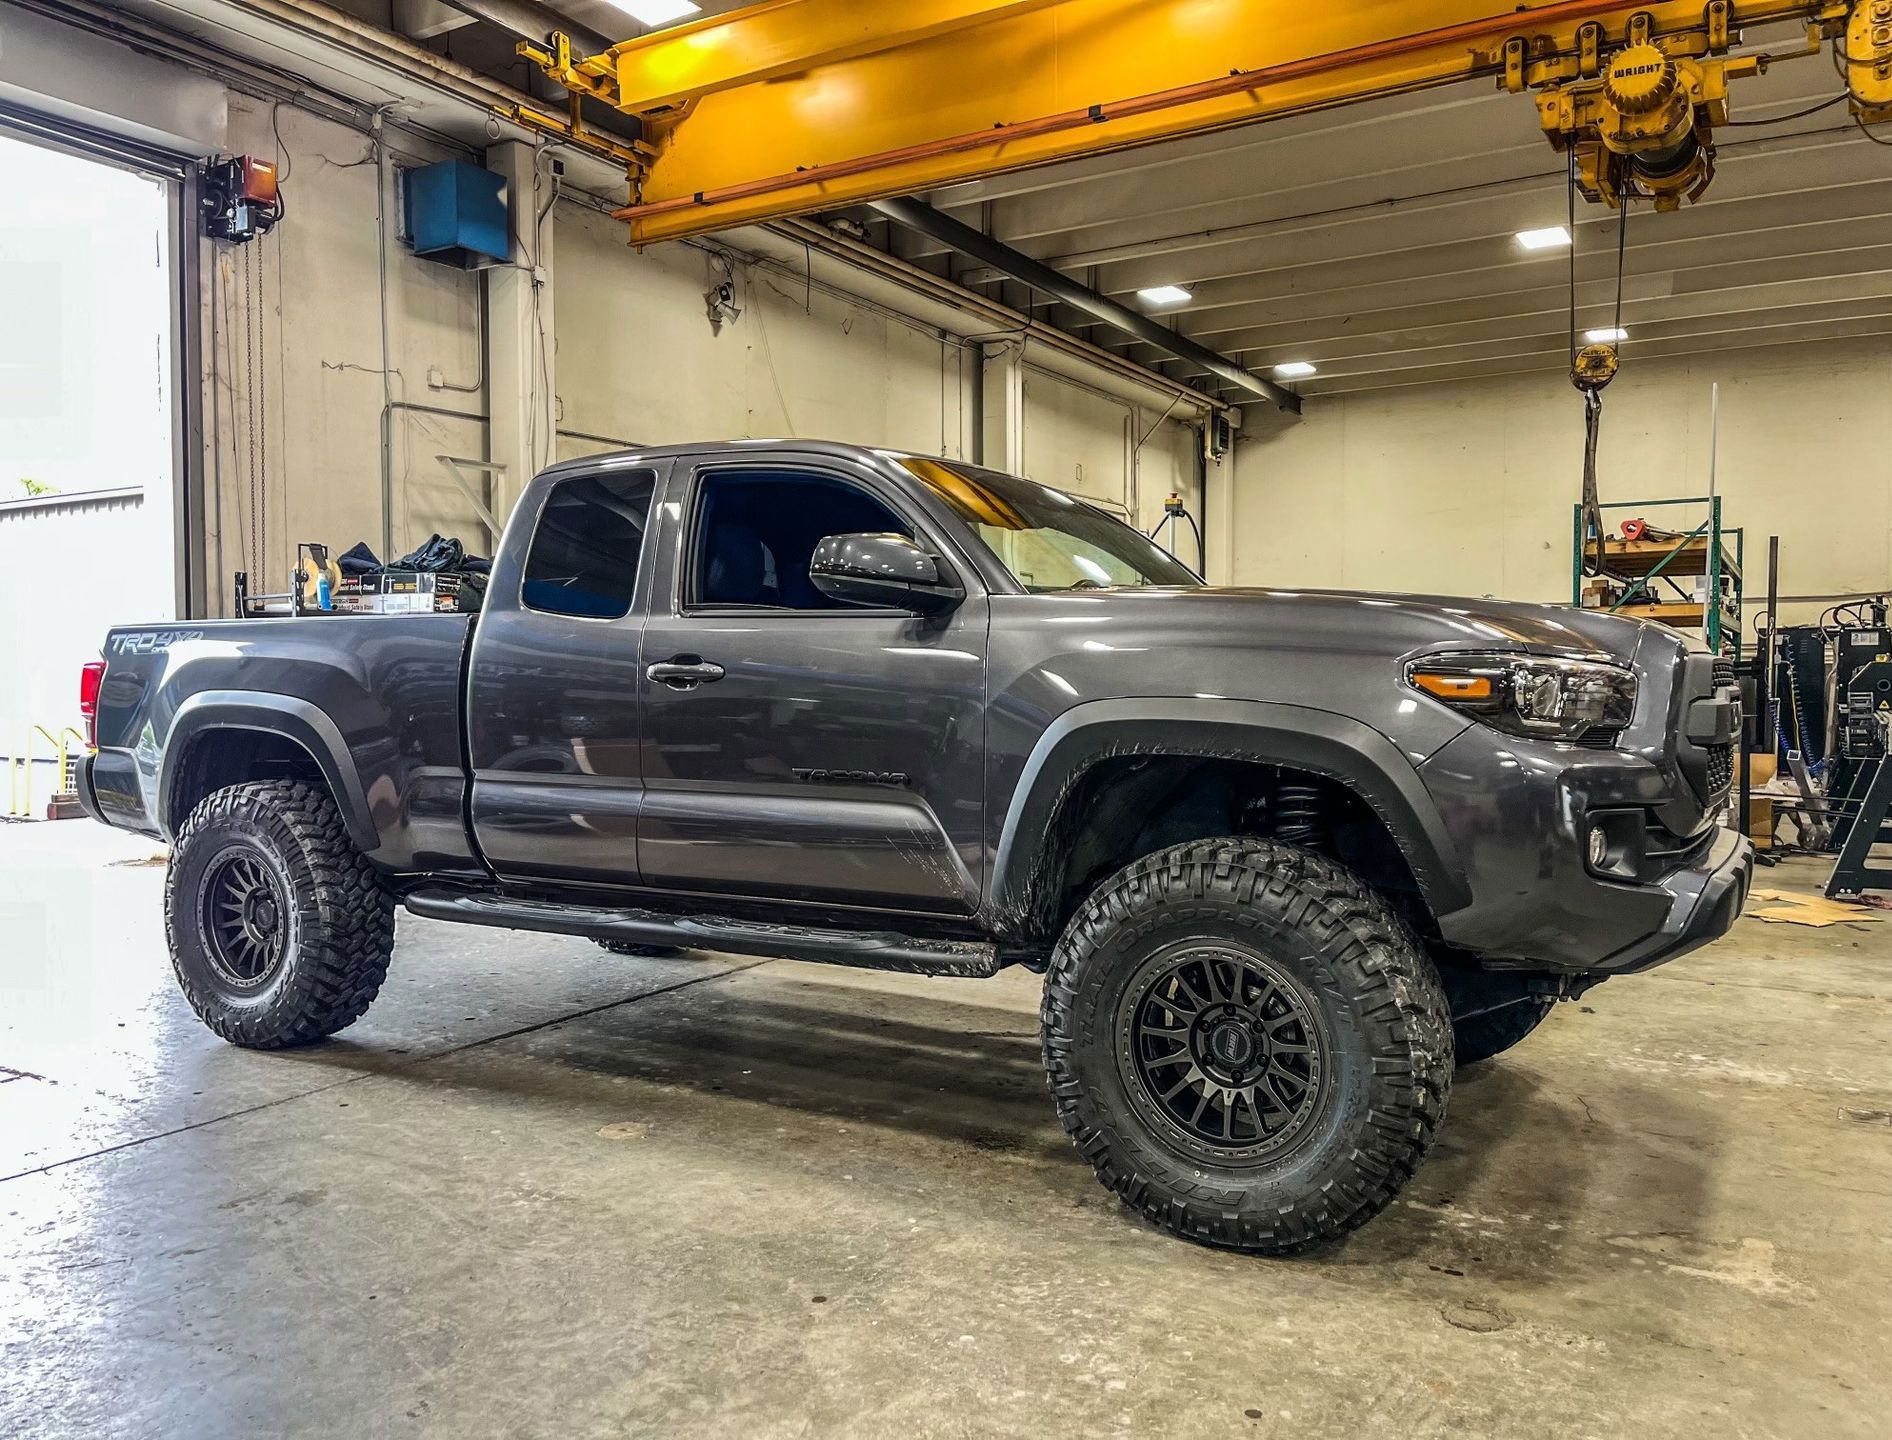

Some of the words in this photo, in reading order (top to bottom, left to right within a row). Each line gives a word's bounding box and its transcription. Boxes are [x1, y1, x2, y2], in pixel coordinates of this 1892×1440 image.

[1614, 64, 1662, 78] WRIGHT
[111, 632, 157, 656] TRD
[791, 767, 913, 785] TACOMA
[1088, 1085, 1248, 1206] NITTO
